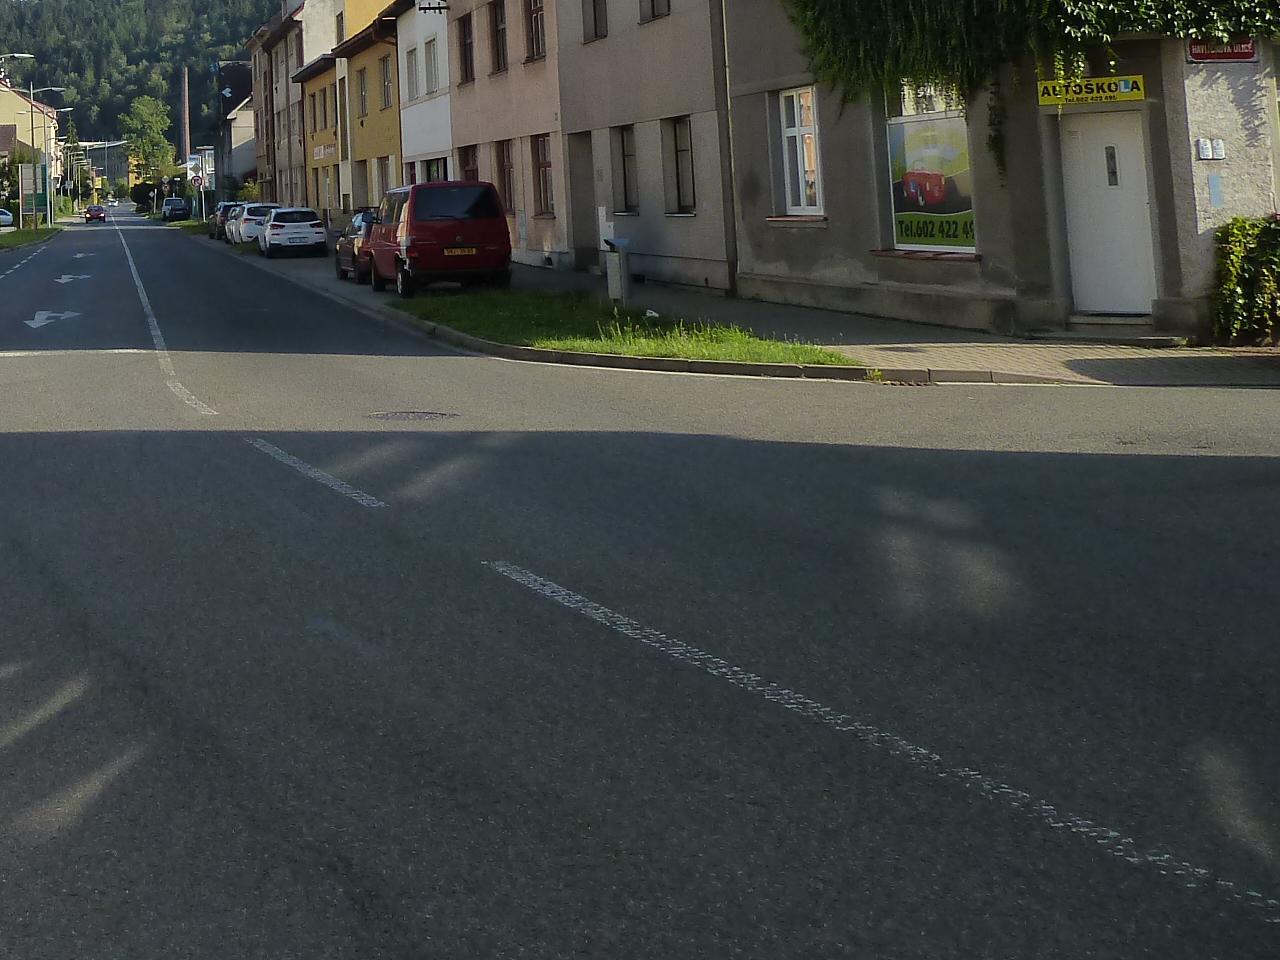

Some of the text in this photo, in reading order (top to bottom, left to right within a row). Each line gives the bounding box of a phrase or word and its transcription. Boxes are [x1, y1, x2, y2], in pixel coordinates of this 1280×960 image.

[1040, 79, 1141, 97] AUTOŠKOLA
[898, 220, 936, 238] Tel.602
[938, 221, 960, 239] 422
